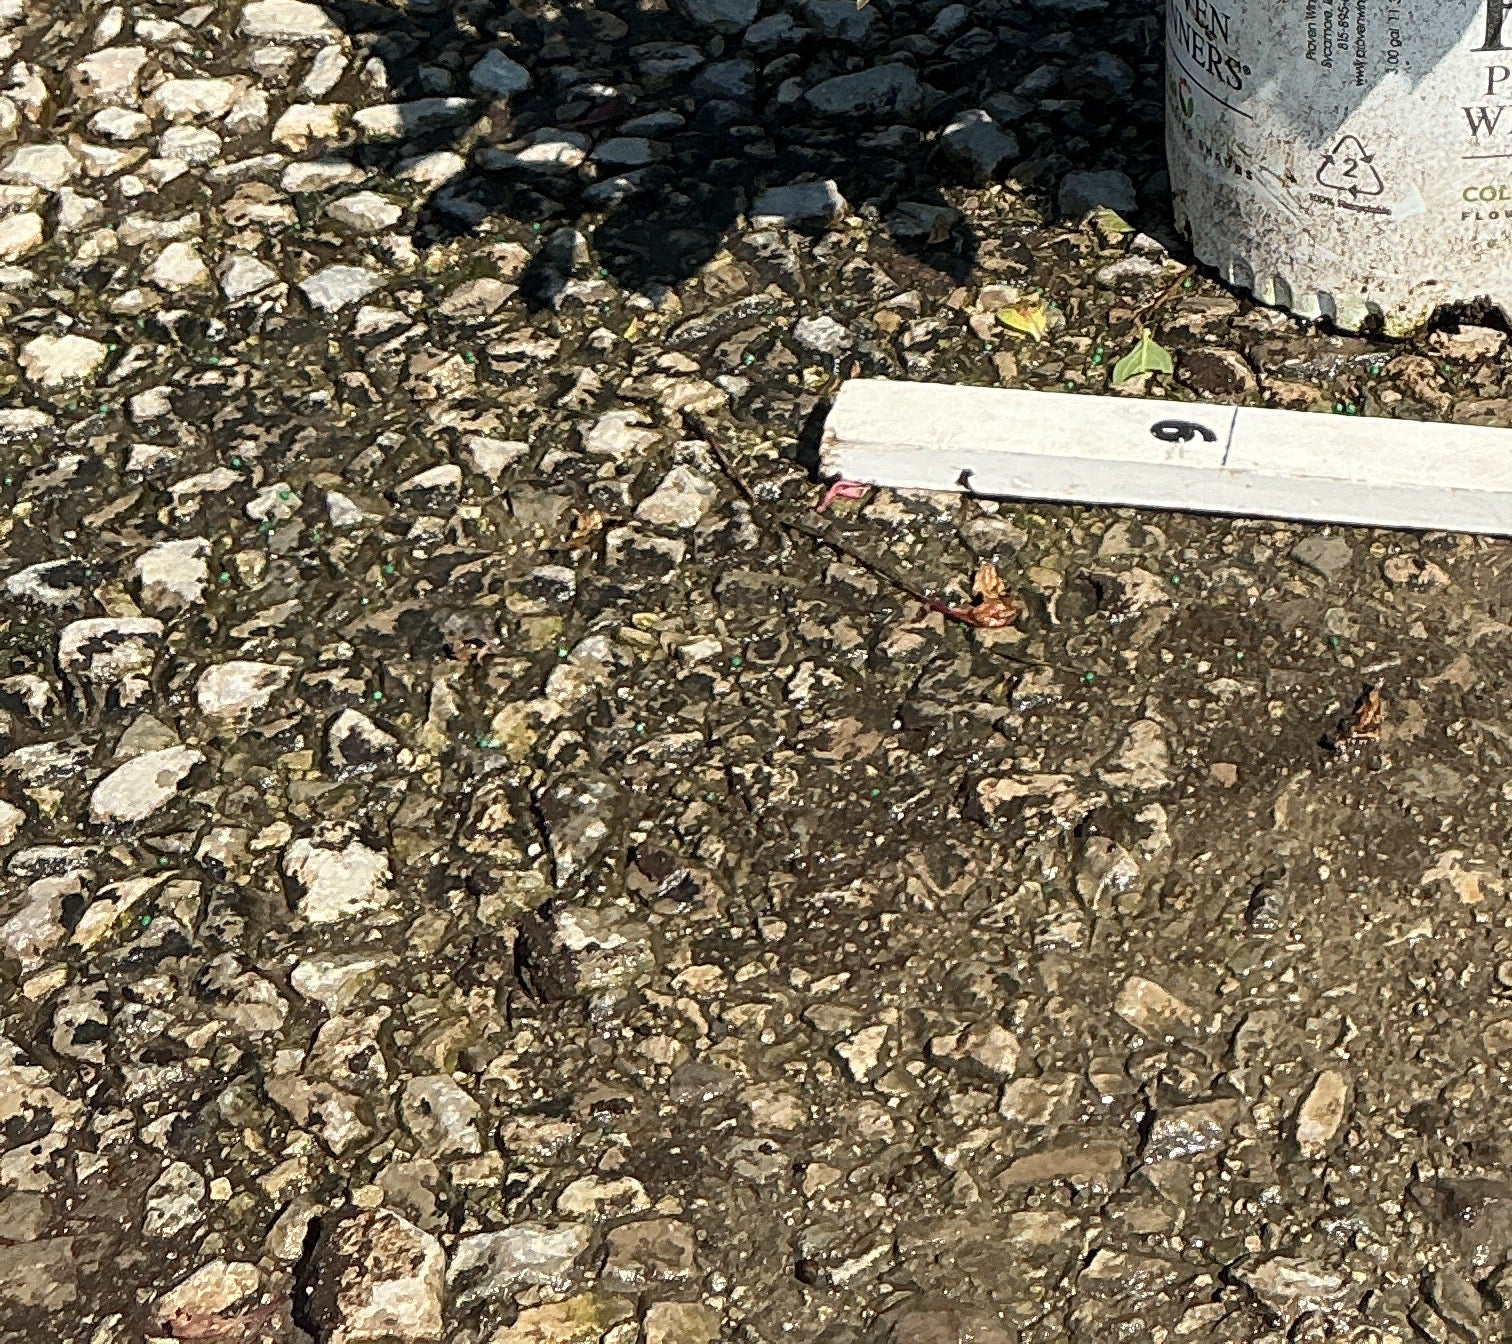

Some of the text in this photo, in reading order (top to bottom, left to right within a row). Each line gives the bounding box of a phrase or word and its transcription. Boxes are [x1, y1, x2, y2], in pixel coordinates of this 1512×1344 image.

[1306, 23, 1318, 61] Proven
[1389, 28, 1402, 48] gal
[1343, 158, 1358, 179] 2
